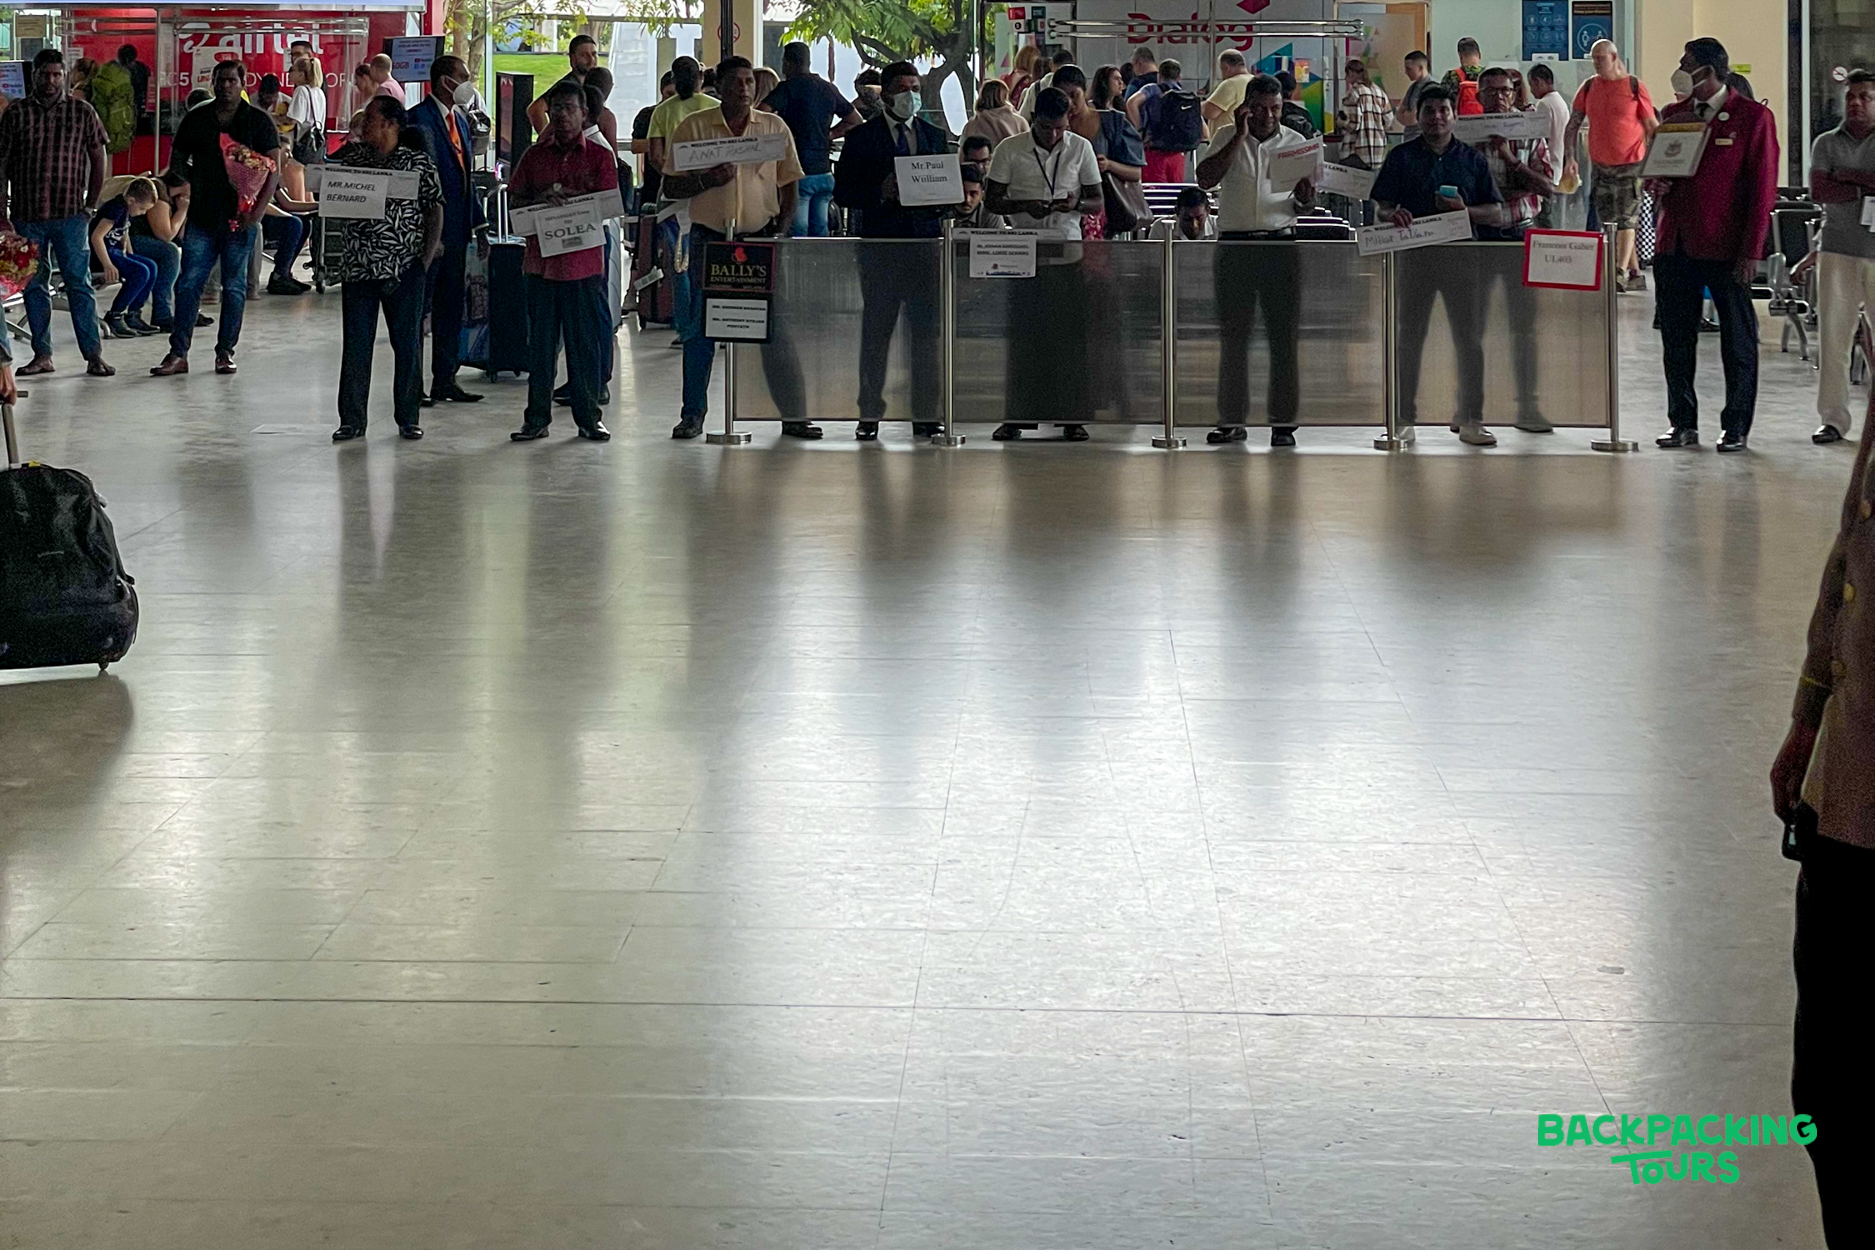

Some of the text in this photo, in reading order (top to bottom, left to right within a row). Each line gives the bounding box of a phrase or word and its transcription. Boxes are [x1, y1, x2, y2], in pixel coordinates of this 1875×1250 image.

[1127, 12, 1254, 50] Dialog
[326, 193, 367, 203] BERNARD
[544, 223, 597, 241] SOLEA
